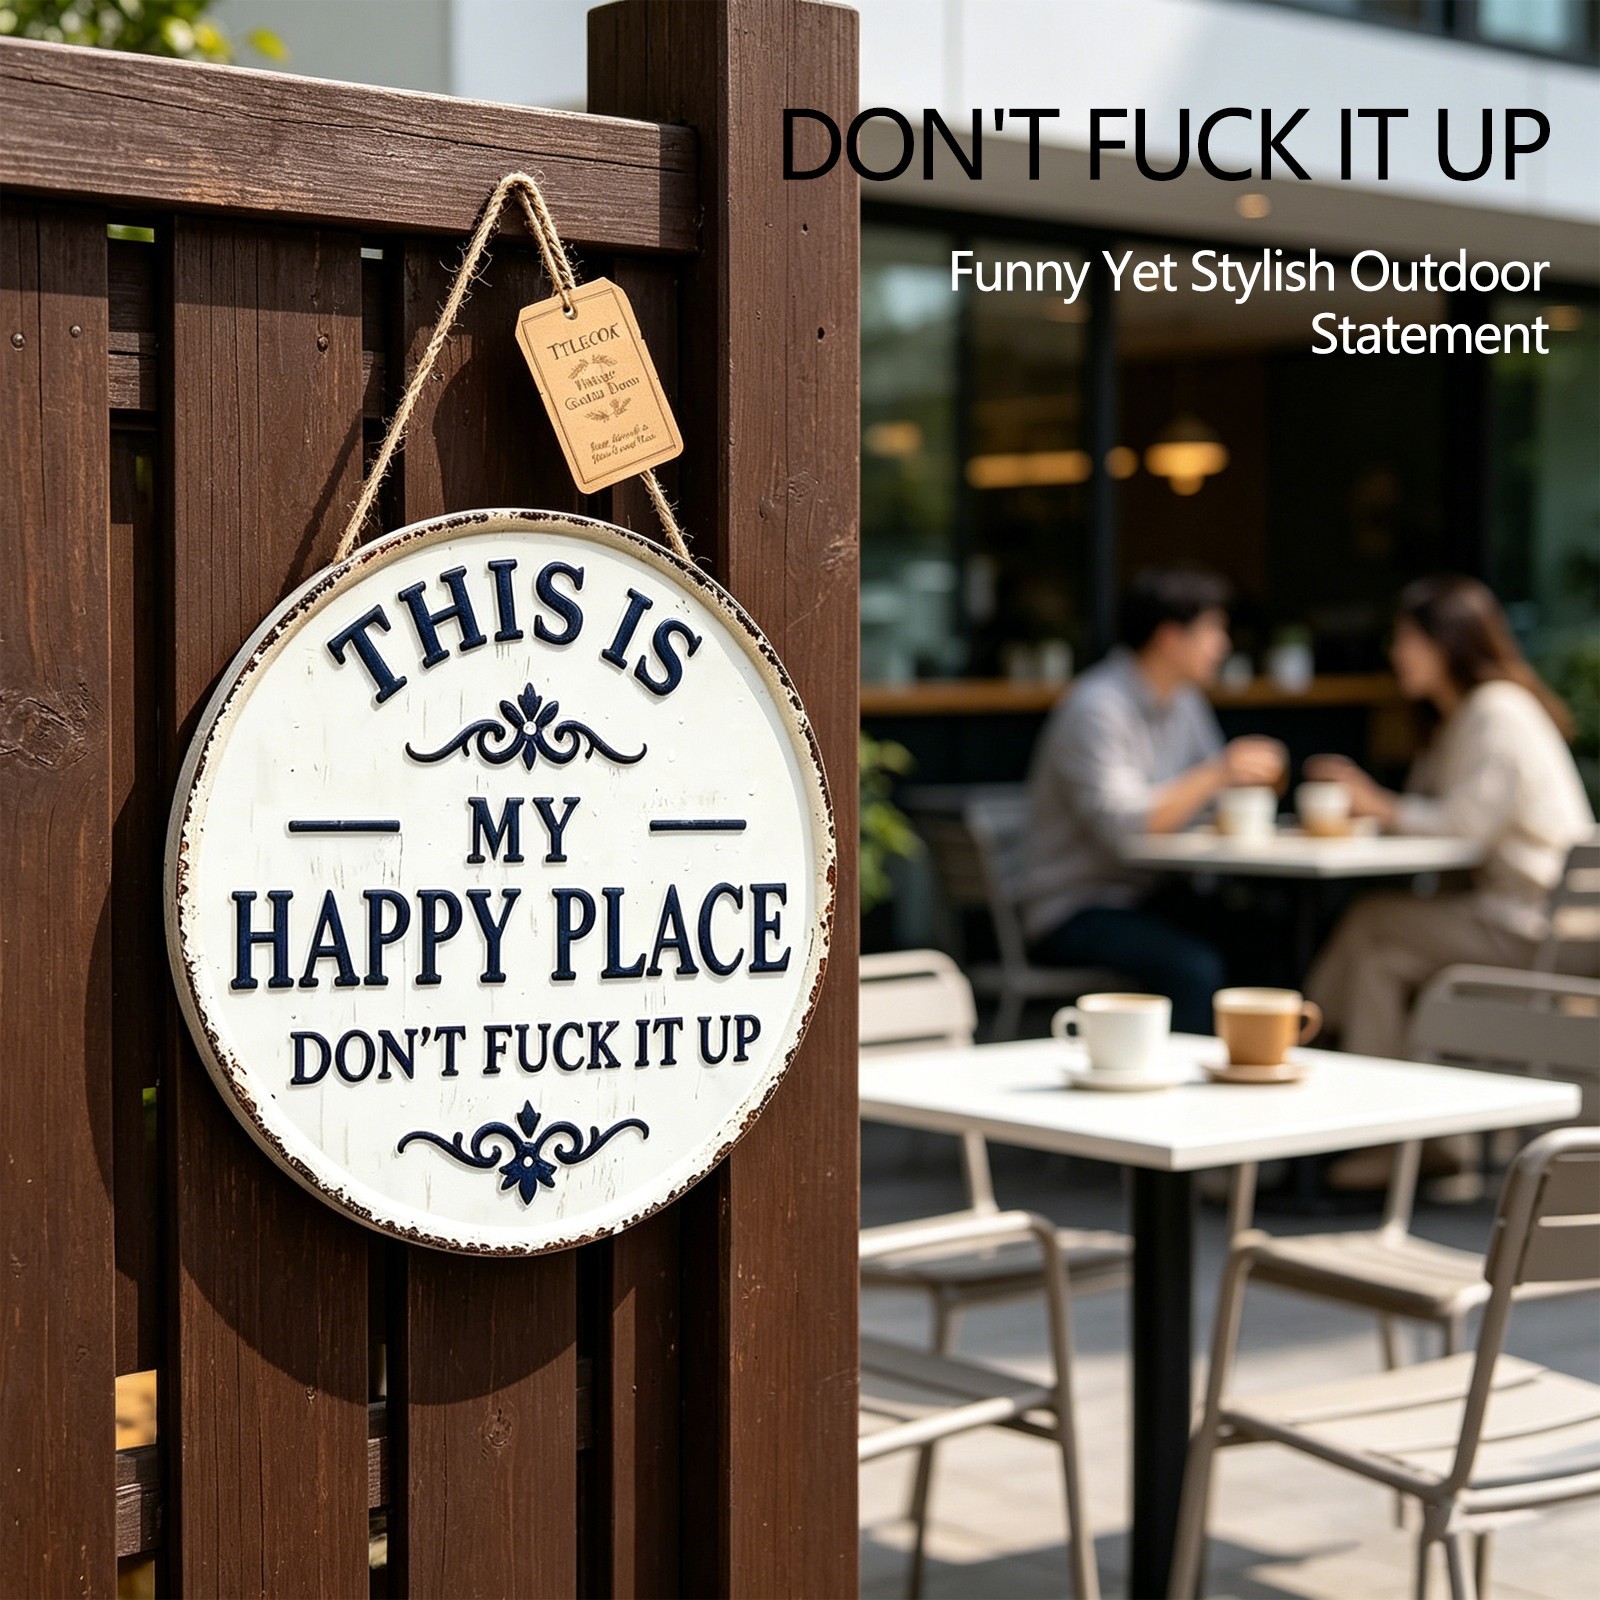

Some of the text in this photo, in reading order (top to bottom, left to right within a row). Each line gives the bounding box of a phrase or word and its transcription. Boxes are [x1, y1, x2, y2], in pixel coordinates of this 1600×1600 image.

[327, 558, 702, 704] THIS IS
[466, 796, 581, 865] MY
[231, 882, 791, 990] HAPPY PLACE
[290, 1015, 761, 1085] DON’T FUCK IT UP
